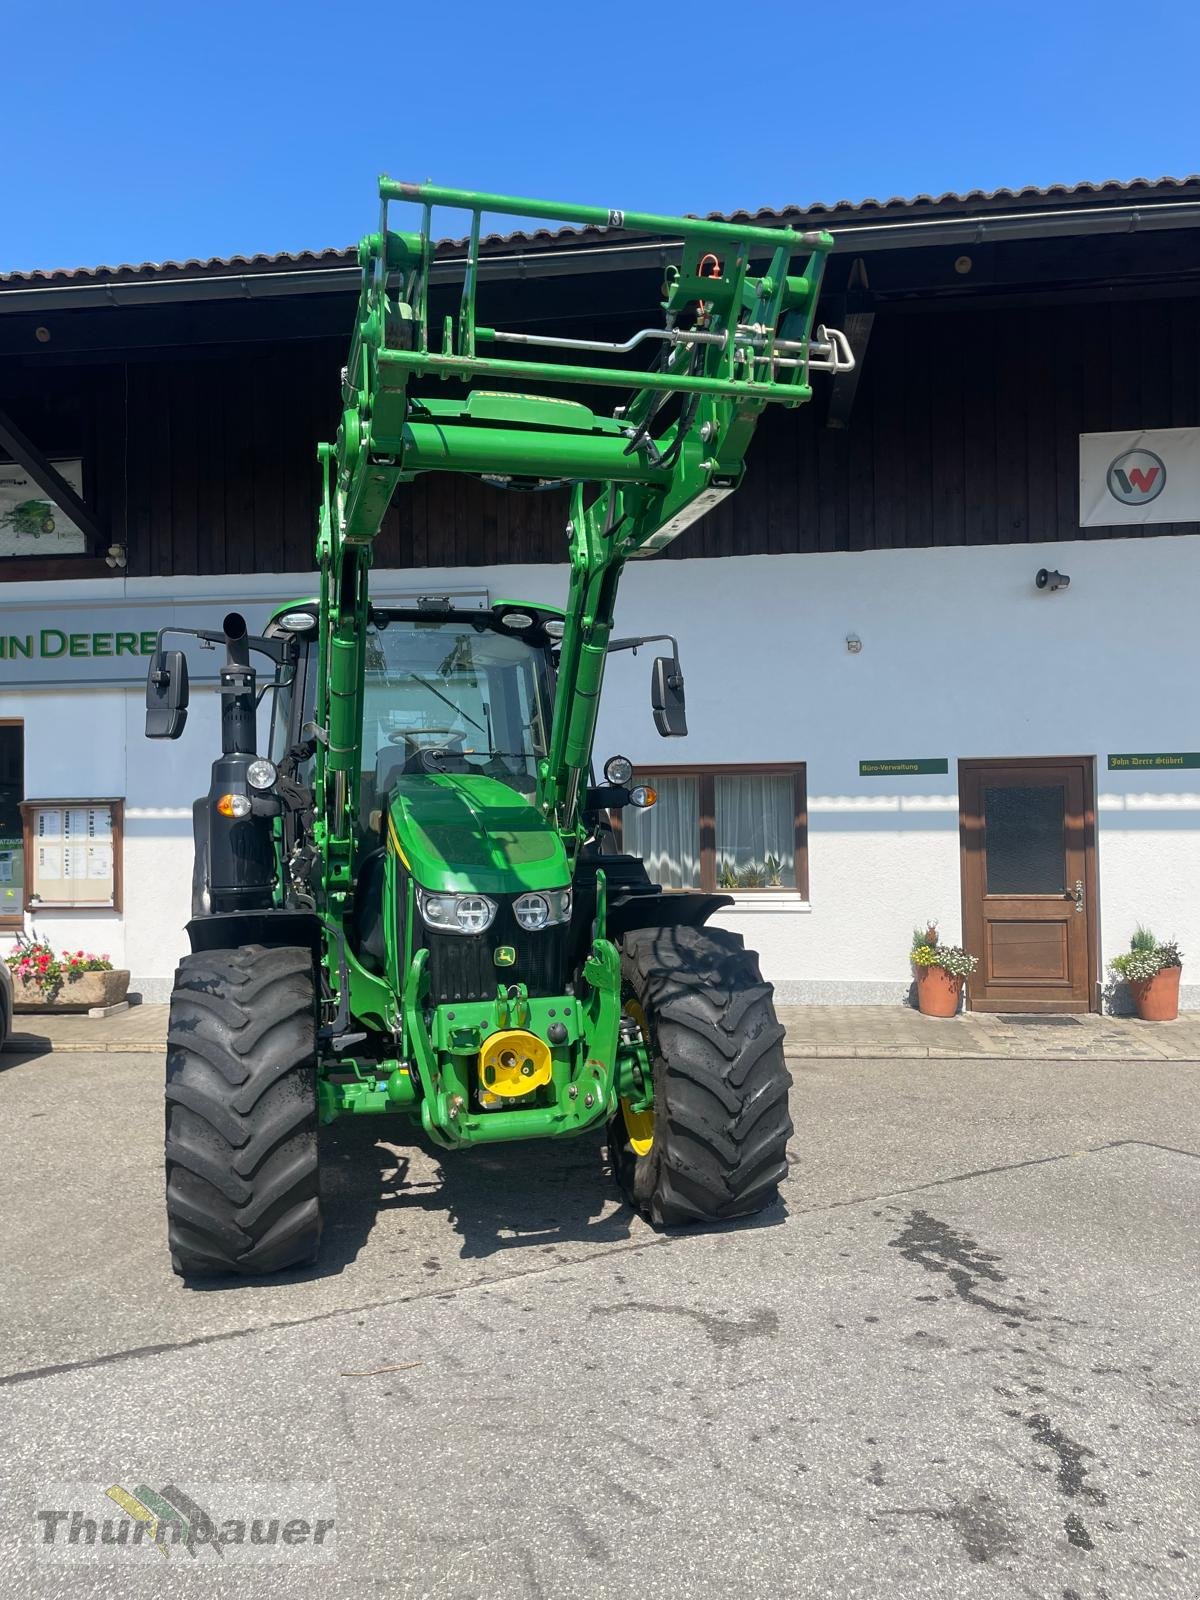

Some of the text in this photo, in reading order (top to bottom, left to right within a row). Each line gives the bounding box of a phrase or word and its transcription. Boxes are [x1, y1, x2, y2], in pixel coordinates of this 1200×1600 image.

[40, 629, 158, 659] DEERE
[1110, 757, 1129, 767] John
[1131, 757, 1153, 765] Deere
[862, 764, 919, 772] Büro-Verwaltung
